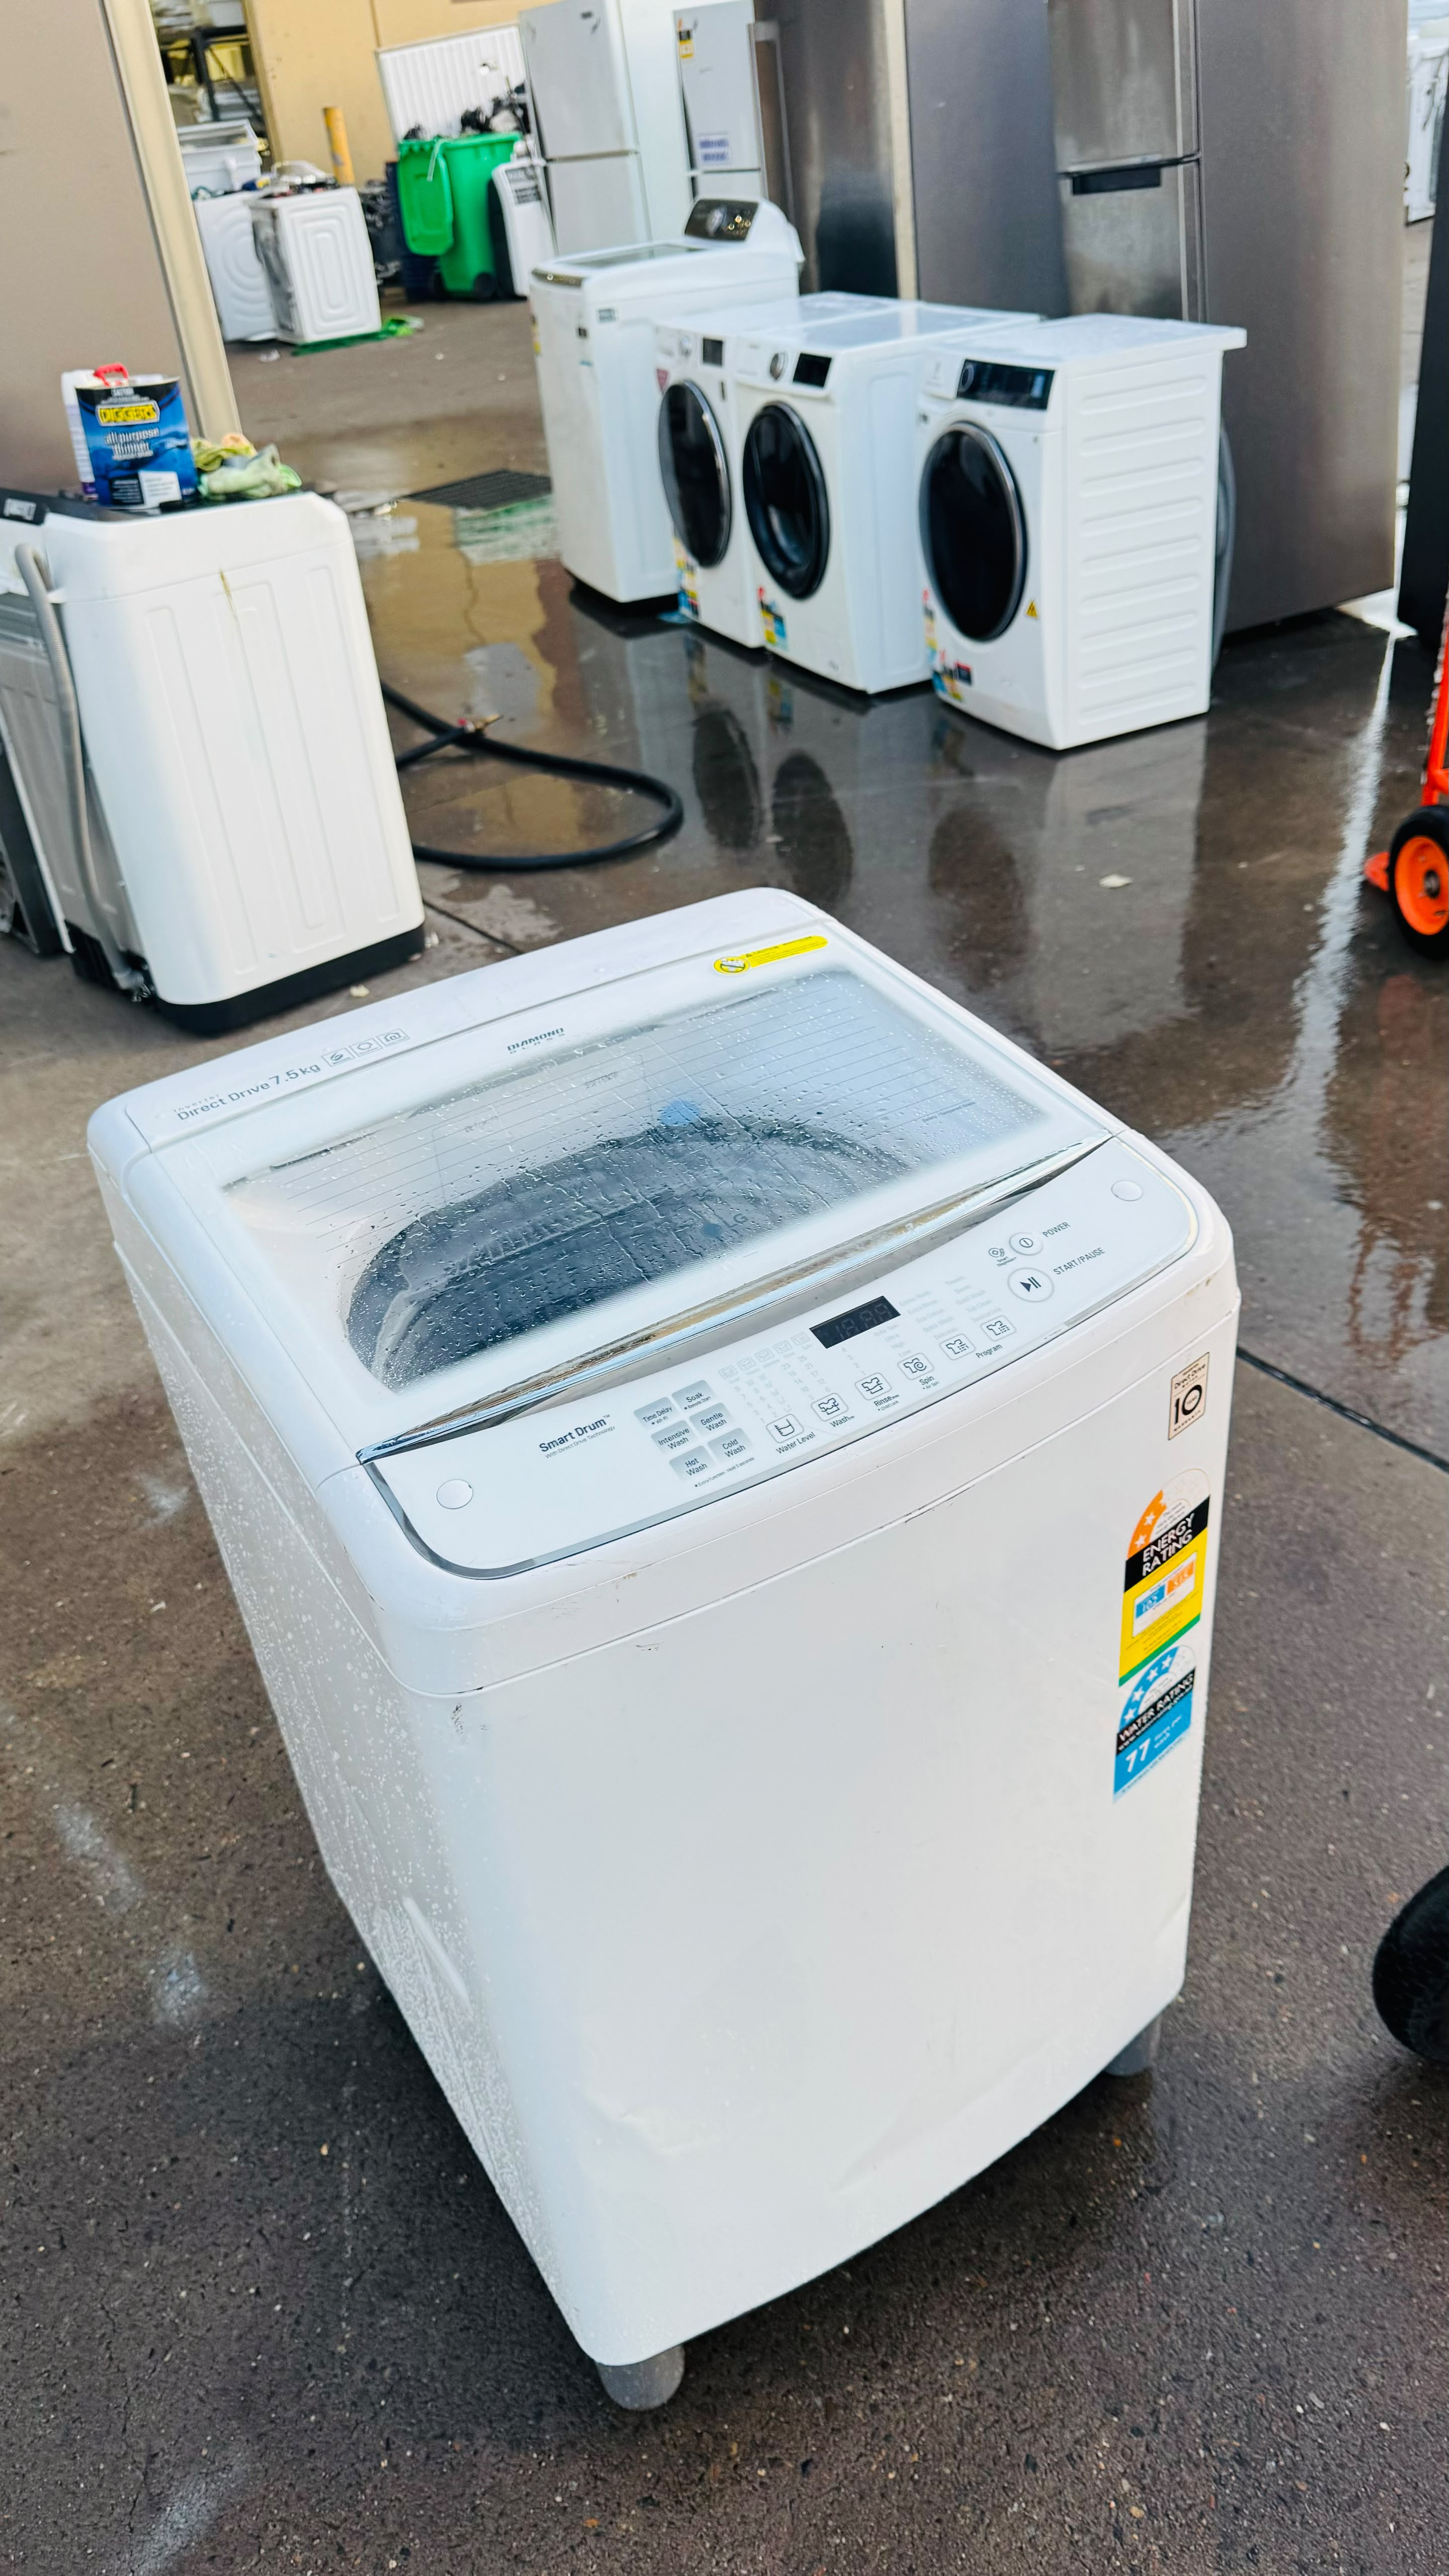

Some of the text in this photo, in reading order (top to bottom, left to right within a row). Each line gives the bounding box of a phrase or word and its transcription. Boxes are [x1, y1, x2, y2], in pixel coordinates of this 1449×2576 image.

[507, 1027, 564, 1051] DIAMOND
[174, 1094, 220, 1112] Inverter
[177, 1098, 226, 1120] Direct
[228, 1082, 270, 1102] Drive
[1042, 1221, 1071, 1237] POWER
[1053, 1247, 1105, 1275] START/PAUSE
[976, 1344, 1003, 1358] Program
[919, 1375, 935, 1386] Spin
[686, 1392, 704, 1403] Soak
[873, 1395, 892, 1407] Rinse
[1174, 1385, 1202, 1425] 10
[642, 1406, 673, 1422] Time Delay
[700, 1412, 723, 1426] Gentle
[830, 1415, 851, 1428] Wash
[706, 1419, 727, 1431] Wash
[539, 1432, 576, 1452] Smart
[557, 1443, 573, 1453] Direct
[573, 1437, 587, 1446] Drive
[587, 1426, 615, 1440] Technology
[658, 1428, 690, 1445] Intensive
[668, 1437, 689, 1450] Wash
[722, 1438, 739, 1450] Cold
[776, 1431, 816, 1454] Water Level
[725, 1444, 746, 1458] Wash
[685, 1458, 699, 1468] Hot
[686, 1463, 708, 1476] Wash
[1143, 1513, 1195, 1562] ENERGY
[1142, 1529, 1193, 1577] RATING
[1119, 1708, 1155, 1741] WATER
[1156, 1673, 1194, 1711] RATING
[1125, 1737, 1151, 1773] 77
